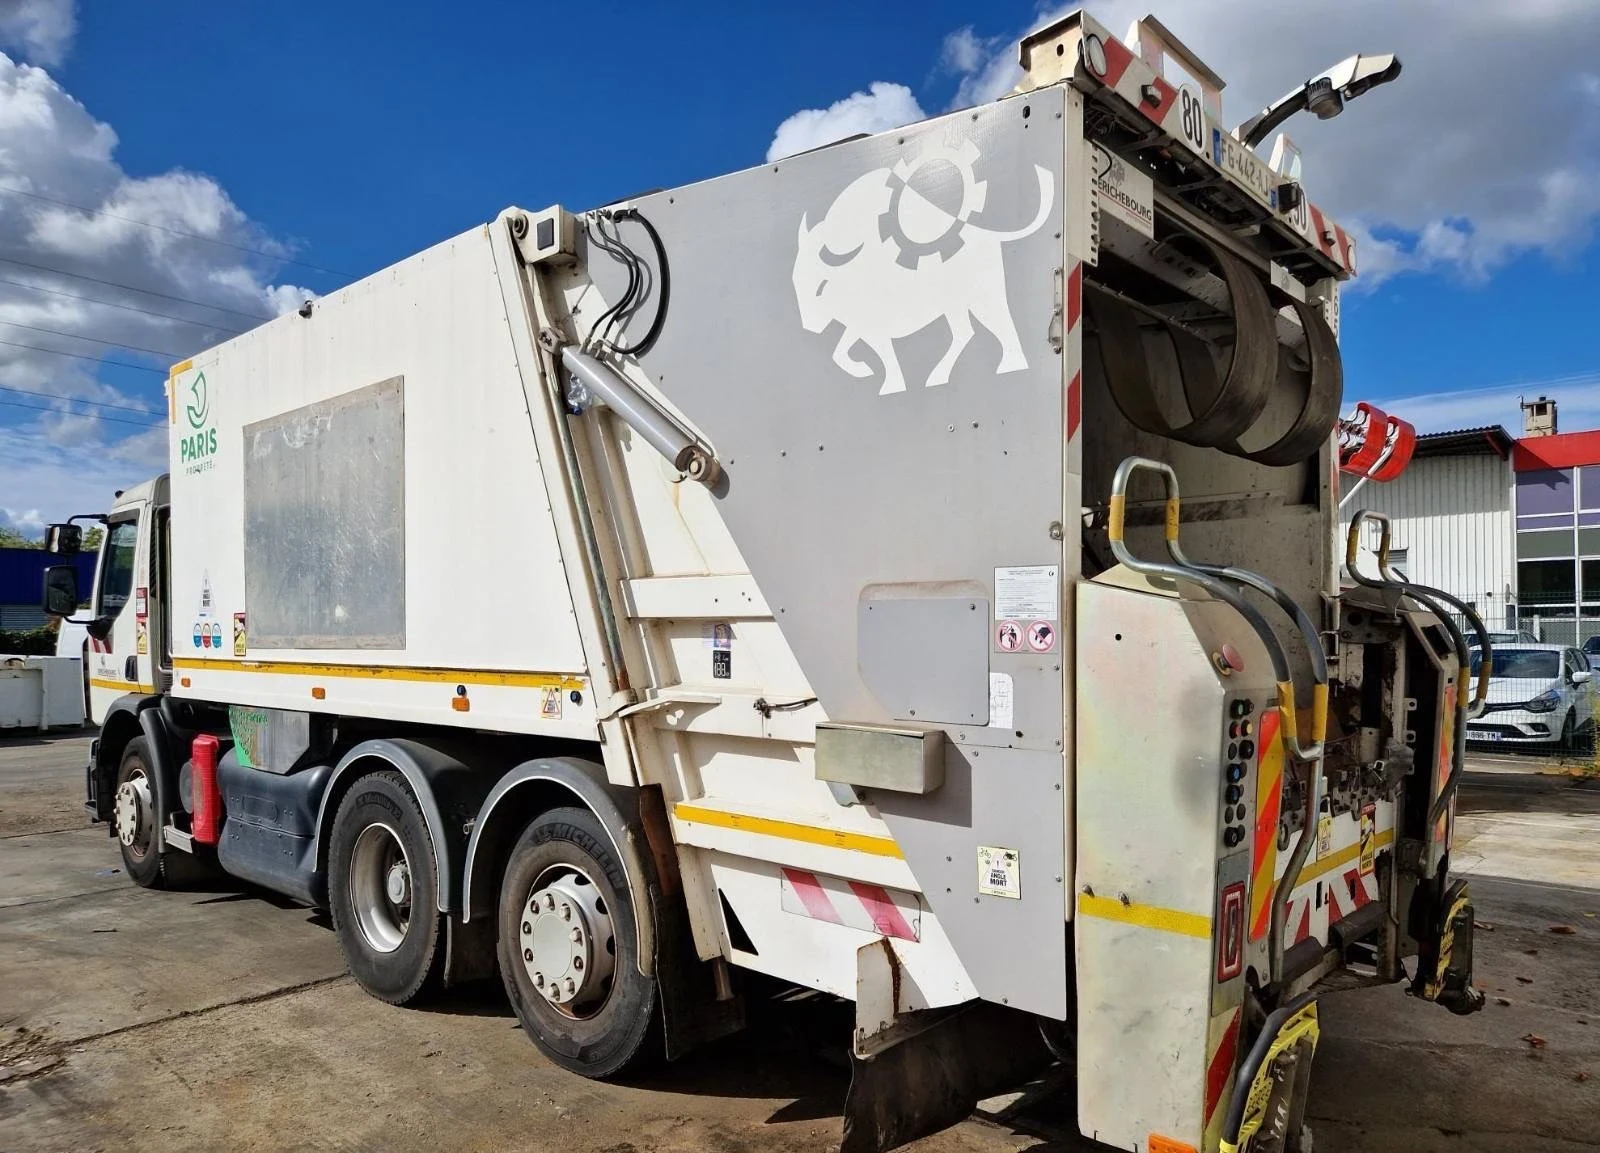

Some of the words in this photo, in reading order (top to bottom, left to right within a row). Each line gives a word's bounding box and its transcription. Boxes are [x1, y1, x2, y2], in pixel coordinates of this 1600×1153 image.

[1182, 89, 1203, 148] 80
[1097, 178, 1152, 221] ERICHEBOURG
[181, 428, 217, 464] PARIS
[990, 878, 1007, 887] MORT
